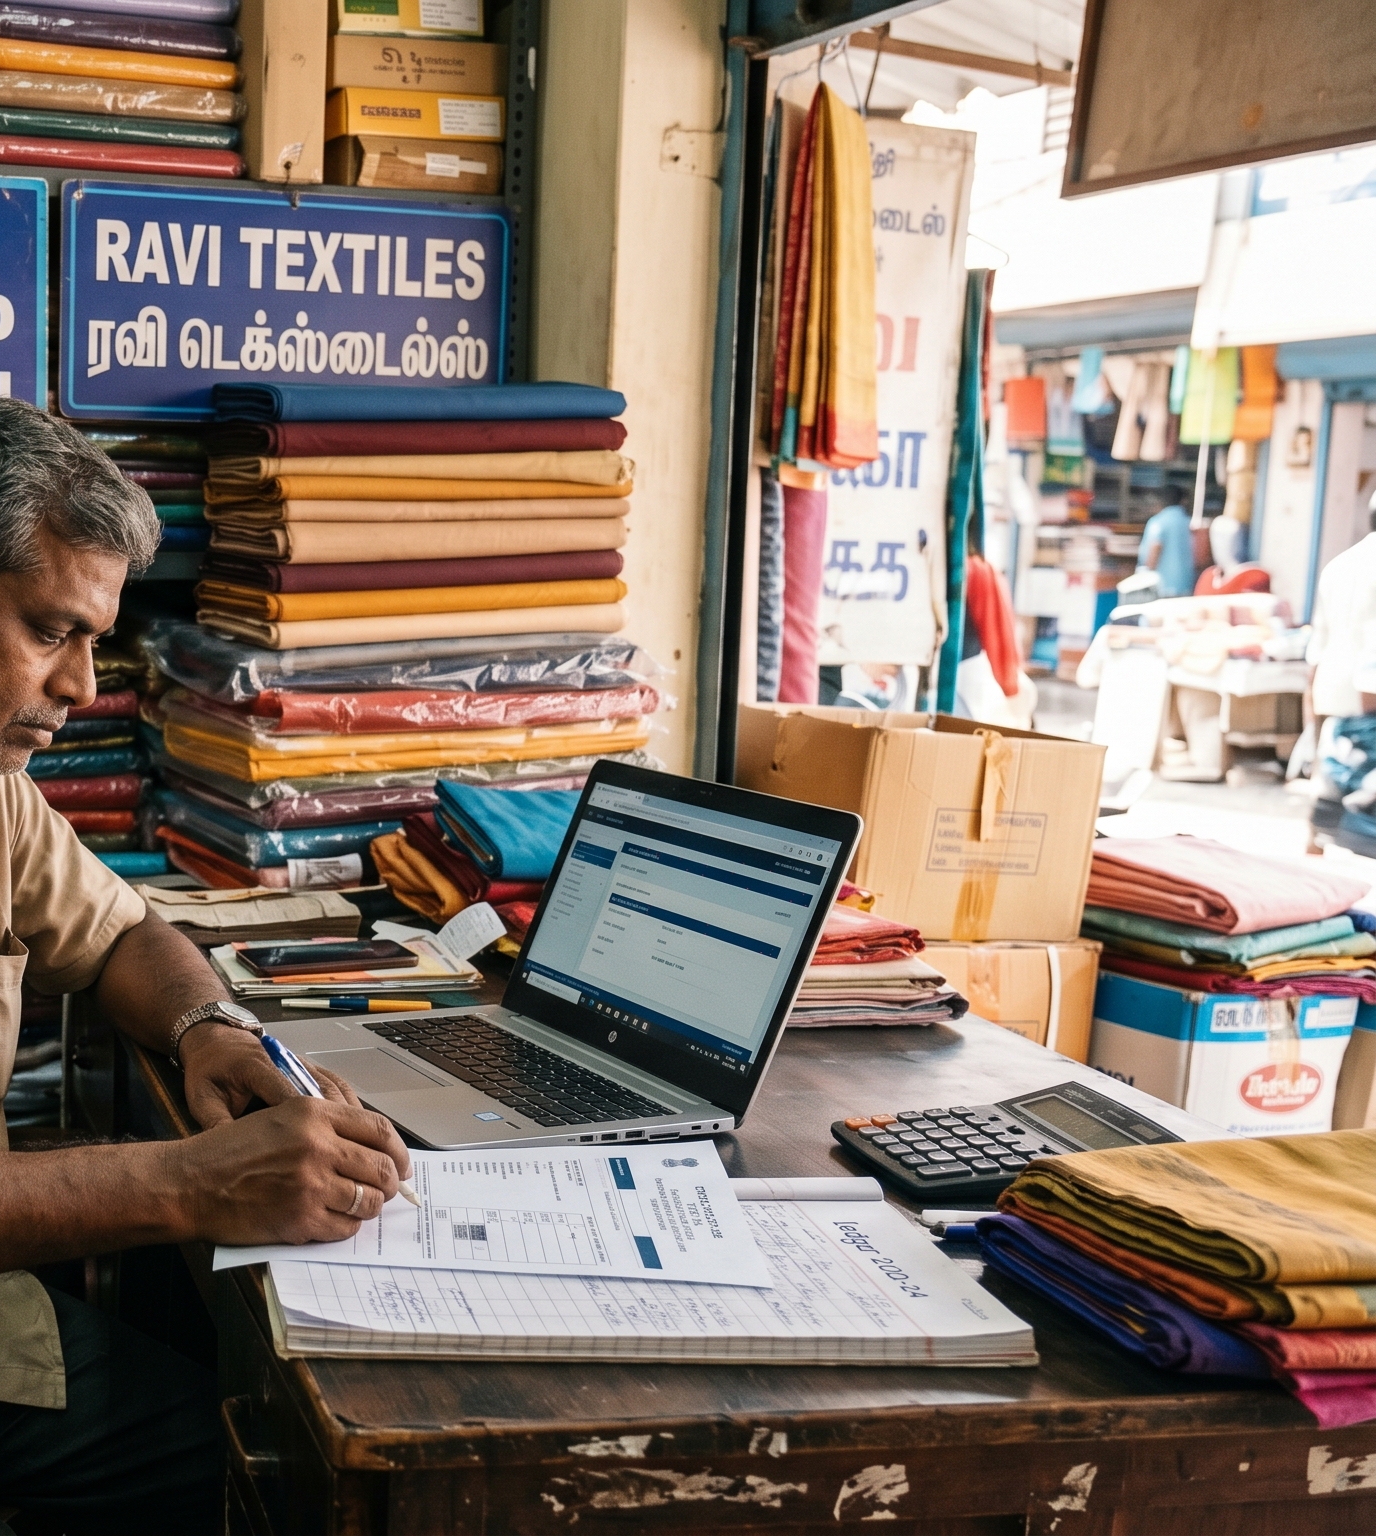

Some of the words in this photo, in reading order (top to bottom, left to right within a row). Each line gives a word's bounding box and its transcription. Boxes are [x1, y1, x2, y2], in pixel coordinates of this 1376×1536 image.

[95, 218, 221, 287] RAVI
[239, 227, 486, 301] TEXTILES
[86, 305, 167, 378] ரவி
[178, 309, 489, 380] டெக்ஸ்டைல்ஸ்
